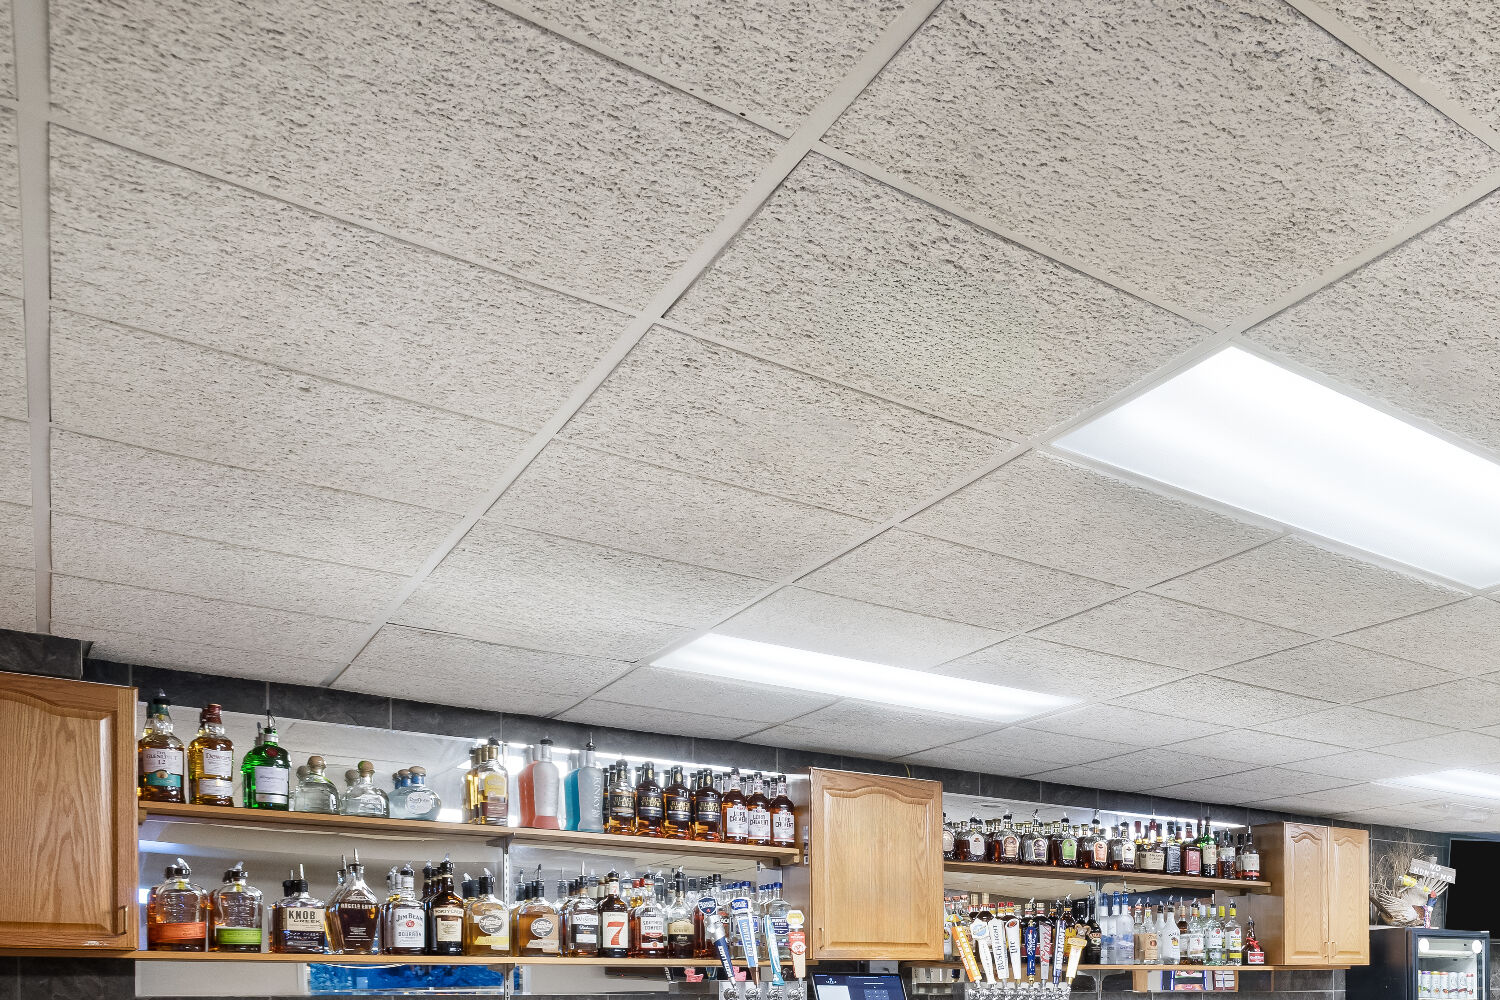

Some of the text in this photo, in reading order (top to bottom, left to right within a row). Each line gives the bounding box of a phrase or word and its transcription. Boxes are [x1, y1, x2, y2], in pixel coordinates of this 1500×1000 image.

[289, 910, 316, 919] KNOB
[607, 922, 625, 945] 7
[996, 945, 1005, 970] BUSCH
